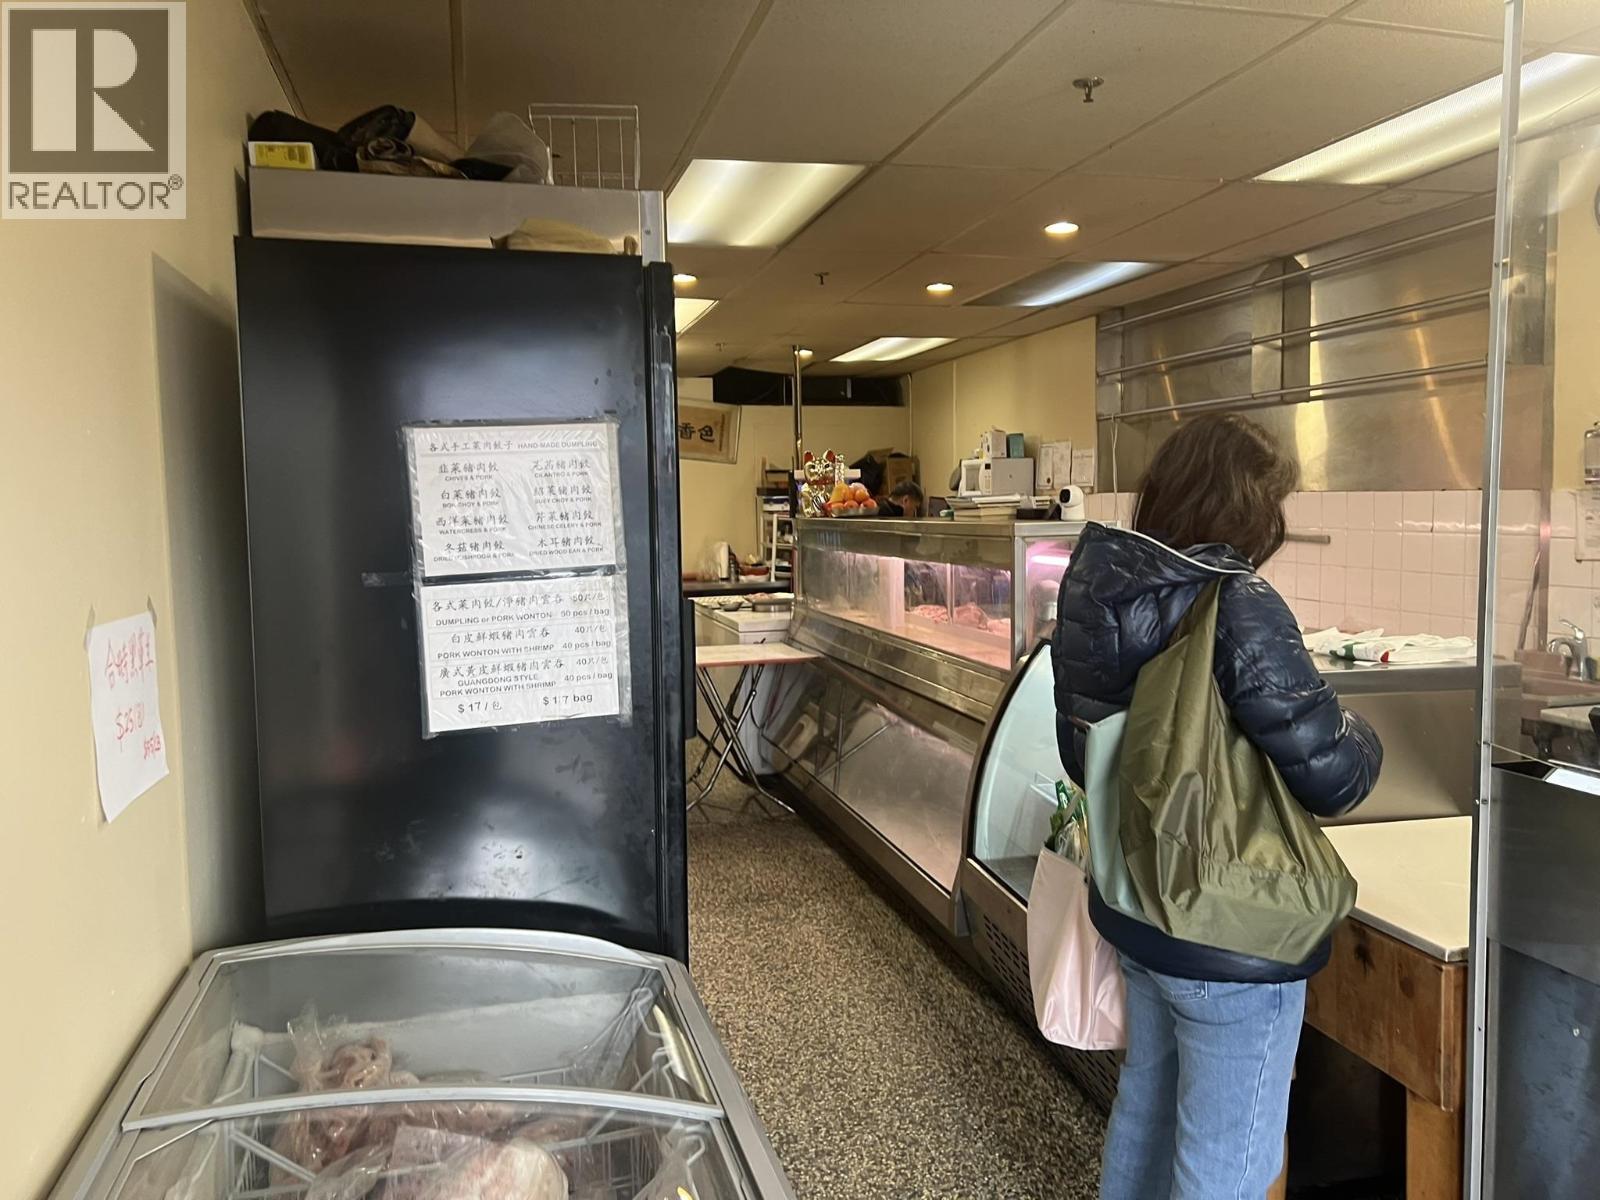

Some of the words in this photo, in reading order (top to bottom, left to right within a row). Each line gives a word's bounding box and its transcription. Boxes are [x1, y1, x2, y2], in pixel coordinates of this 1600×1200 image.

[561, 440, 599, 448] DUMPLING
[435, 616, 480, 626] DUMPLING
[491, 614, 514, 623] PORK
[516, 612, 553, 620] WONTON
[437, 651, 461, 660] PORK
[463, 648, 500, 657] WONTON
[524, 644, 554, 653] SHRIMP
[457, 676, 512, 687] GUANGDONG
[514, 674, 538, 682] STYLE
[597, 672, 613, 680] bag
[440, 688, 463, 697] PORK
[465, 686, 503, 696] WONTON
[504, 684, 525, 693] WITH
[526, 680, 557, 690] SHRIMP
[573, 693, 593, 704] bag
